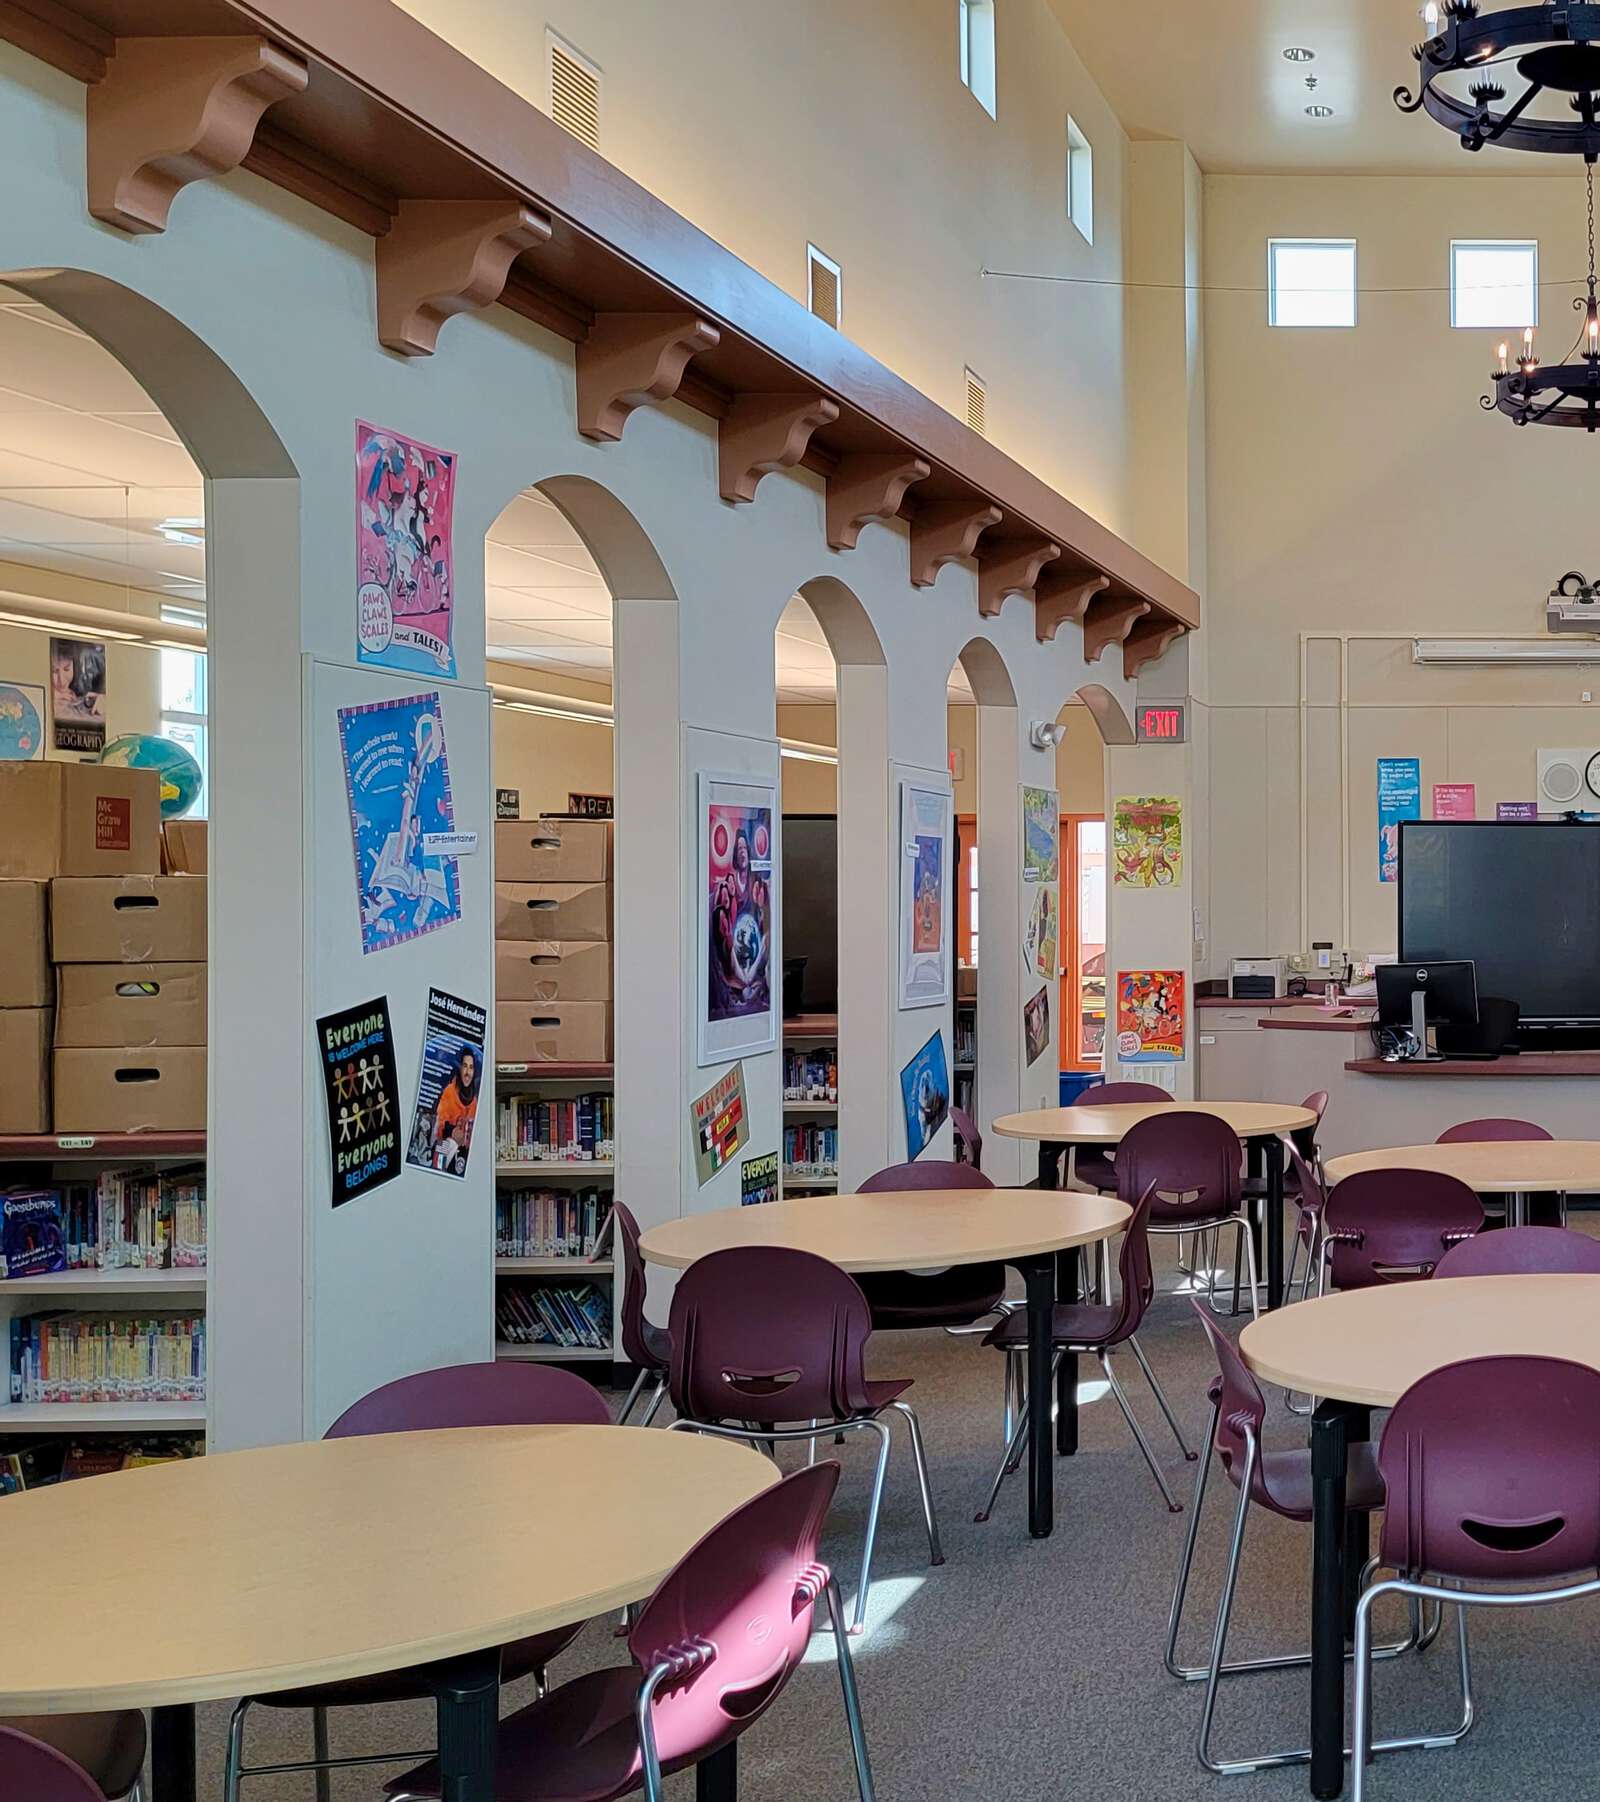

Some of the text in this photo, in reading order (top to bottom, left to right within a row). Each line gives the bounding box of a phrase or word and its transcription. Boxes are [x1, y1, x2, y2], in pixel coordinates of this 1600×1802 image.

[362, 607, 388, 623] CLAWS
[394, 631, 444, 655] and TALES!
[1145, 711, 1179, 737] EXIT
[98, 801, 113, 812] Mc
[97, 813, 122, 825] Graw
[97, 826, 113, 838] Hill
[430, 991, 485, 1025] José Hernández
[326, 1013, 385, 1050] Everyone
[337, 1132, 394, 1173] Everyone
[346, 1154, 388, 1189] BELONGS
[742, 1156, 778, 1181] EVERYONE
[4, 1197, 56, 1220] Goosebumps
